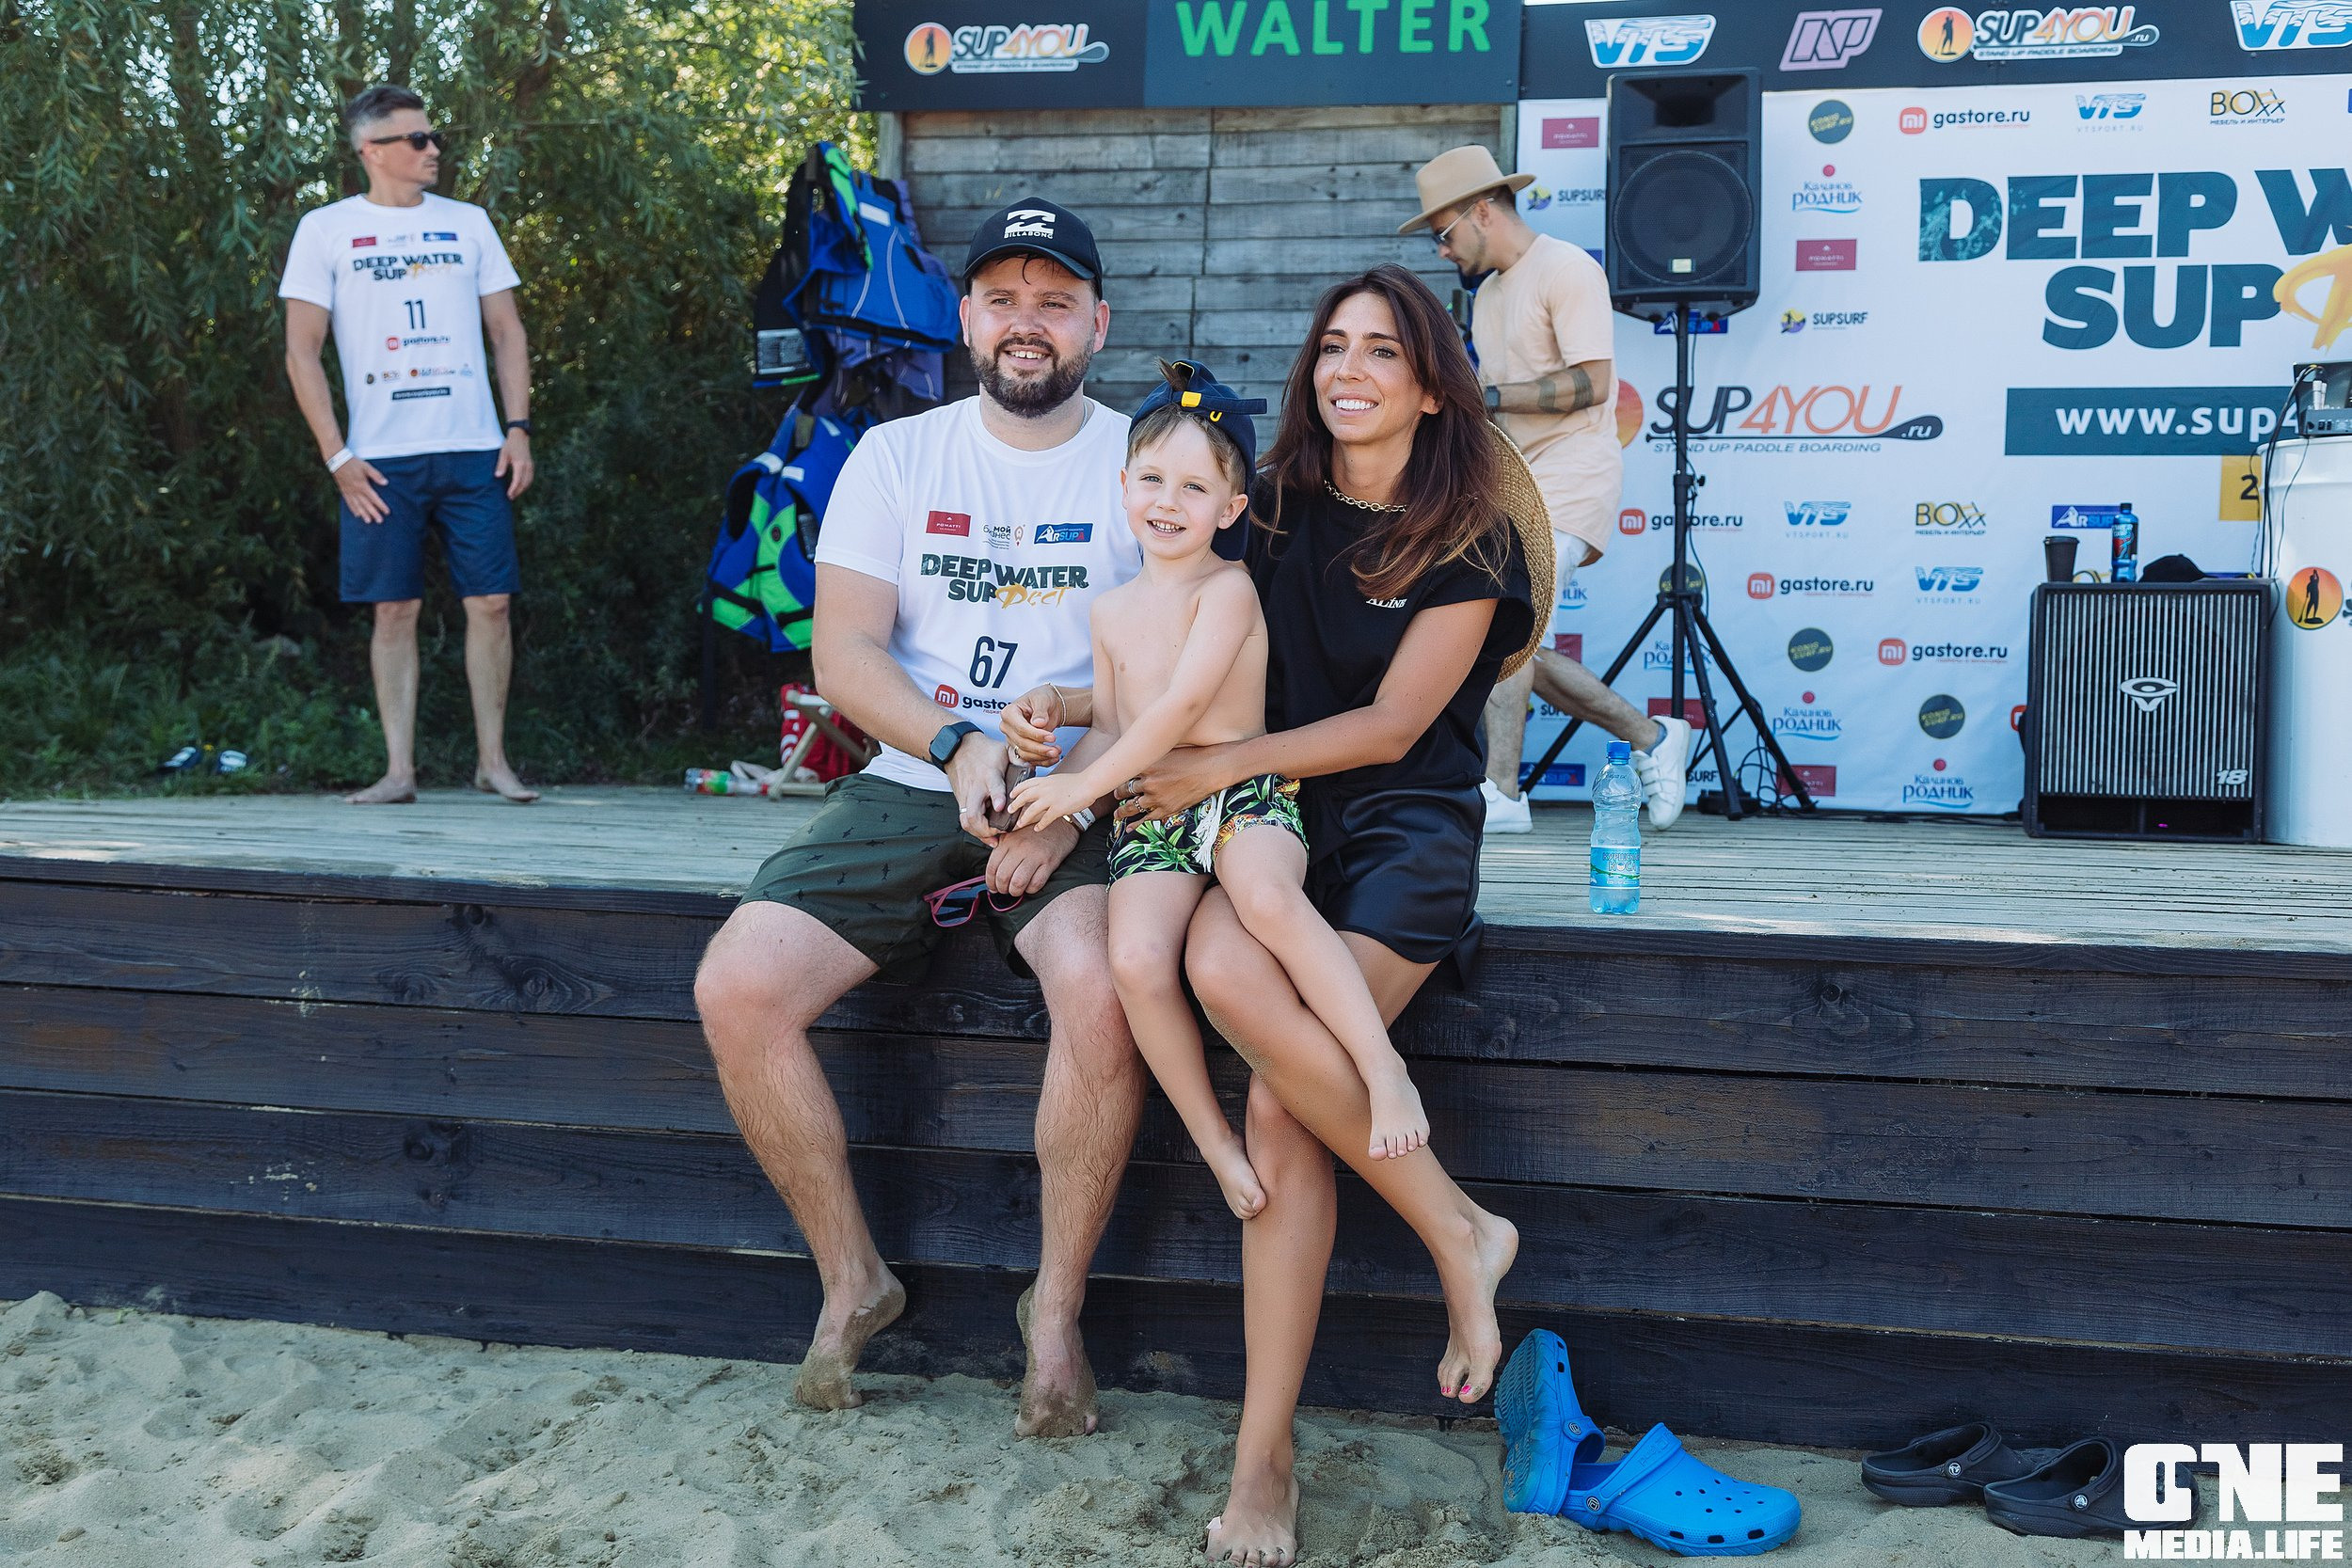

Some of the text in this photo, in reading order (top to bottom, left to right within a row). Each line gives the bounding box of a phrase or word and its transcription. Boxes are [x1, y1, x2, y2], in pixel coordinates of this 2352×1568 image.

[1176, 0, 1492, 57] WALTER
[1977, 9, 2132, 45] SUP4YOU
[953, 26, 1087, 57] SUP4YOU
[1933, 109, 2030, 129] gastore.ru
[1558, 189, 1606, 202] SUPSUR
[1918, 171, 2238, 261] DEEP
[1004, 230, 1054, 240] BILLABONG
[353, 255, 398, 272] DEEP
[403, 253, 464, 267] WATER
[373, 267, 407, 281] SUP
[405, 299, 426, 330] 11
[2042, 263, 2285, 350] SUP
[1813, 312, 1868, 325] SUPSURF
[1650, 384, 1903, 435] SUP4YOU
[2055, 403, 2300, 444] www.sup4
[1708, 443, 1730, 453] UP
[1733, 443, 1795, 453] PADDLE
[1799, 443, 1882, 453] BOARDING
[2239, 474, 2259, 500] 2
[1651, 515, 1743, 530] gaore.ru
[920, 553, 1089, 590] DEEP WATER
[948, 578, 997, 603] SUP
[1780, 576, 1874, 594] gastore.ru
[969, 635, 1019, 689] 67
[1912, 642, 2008, 661] gastore.ru
[962, 695, 1011, 710] gasto
[2216, 768, 2249, 785] 18
